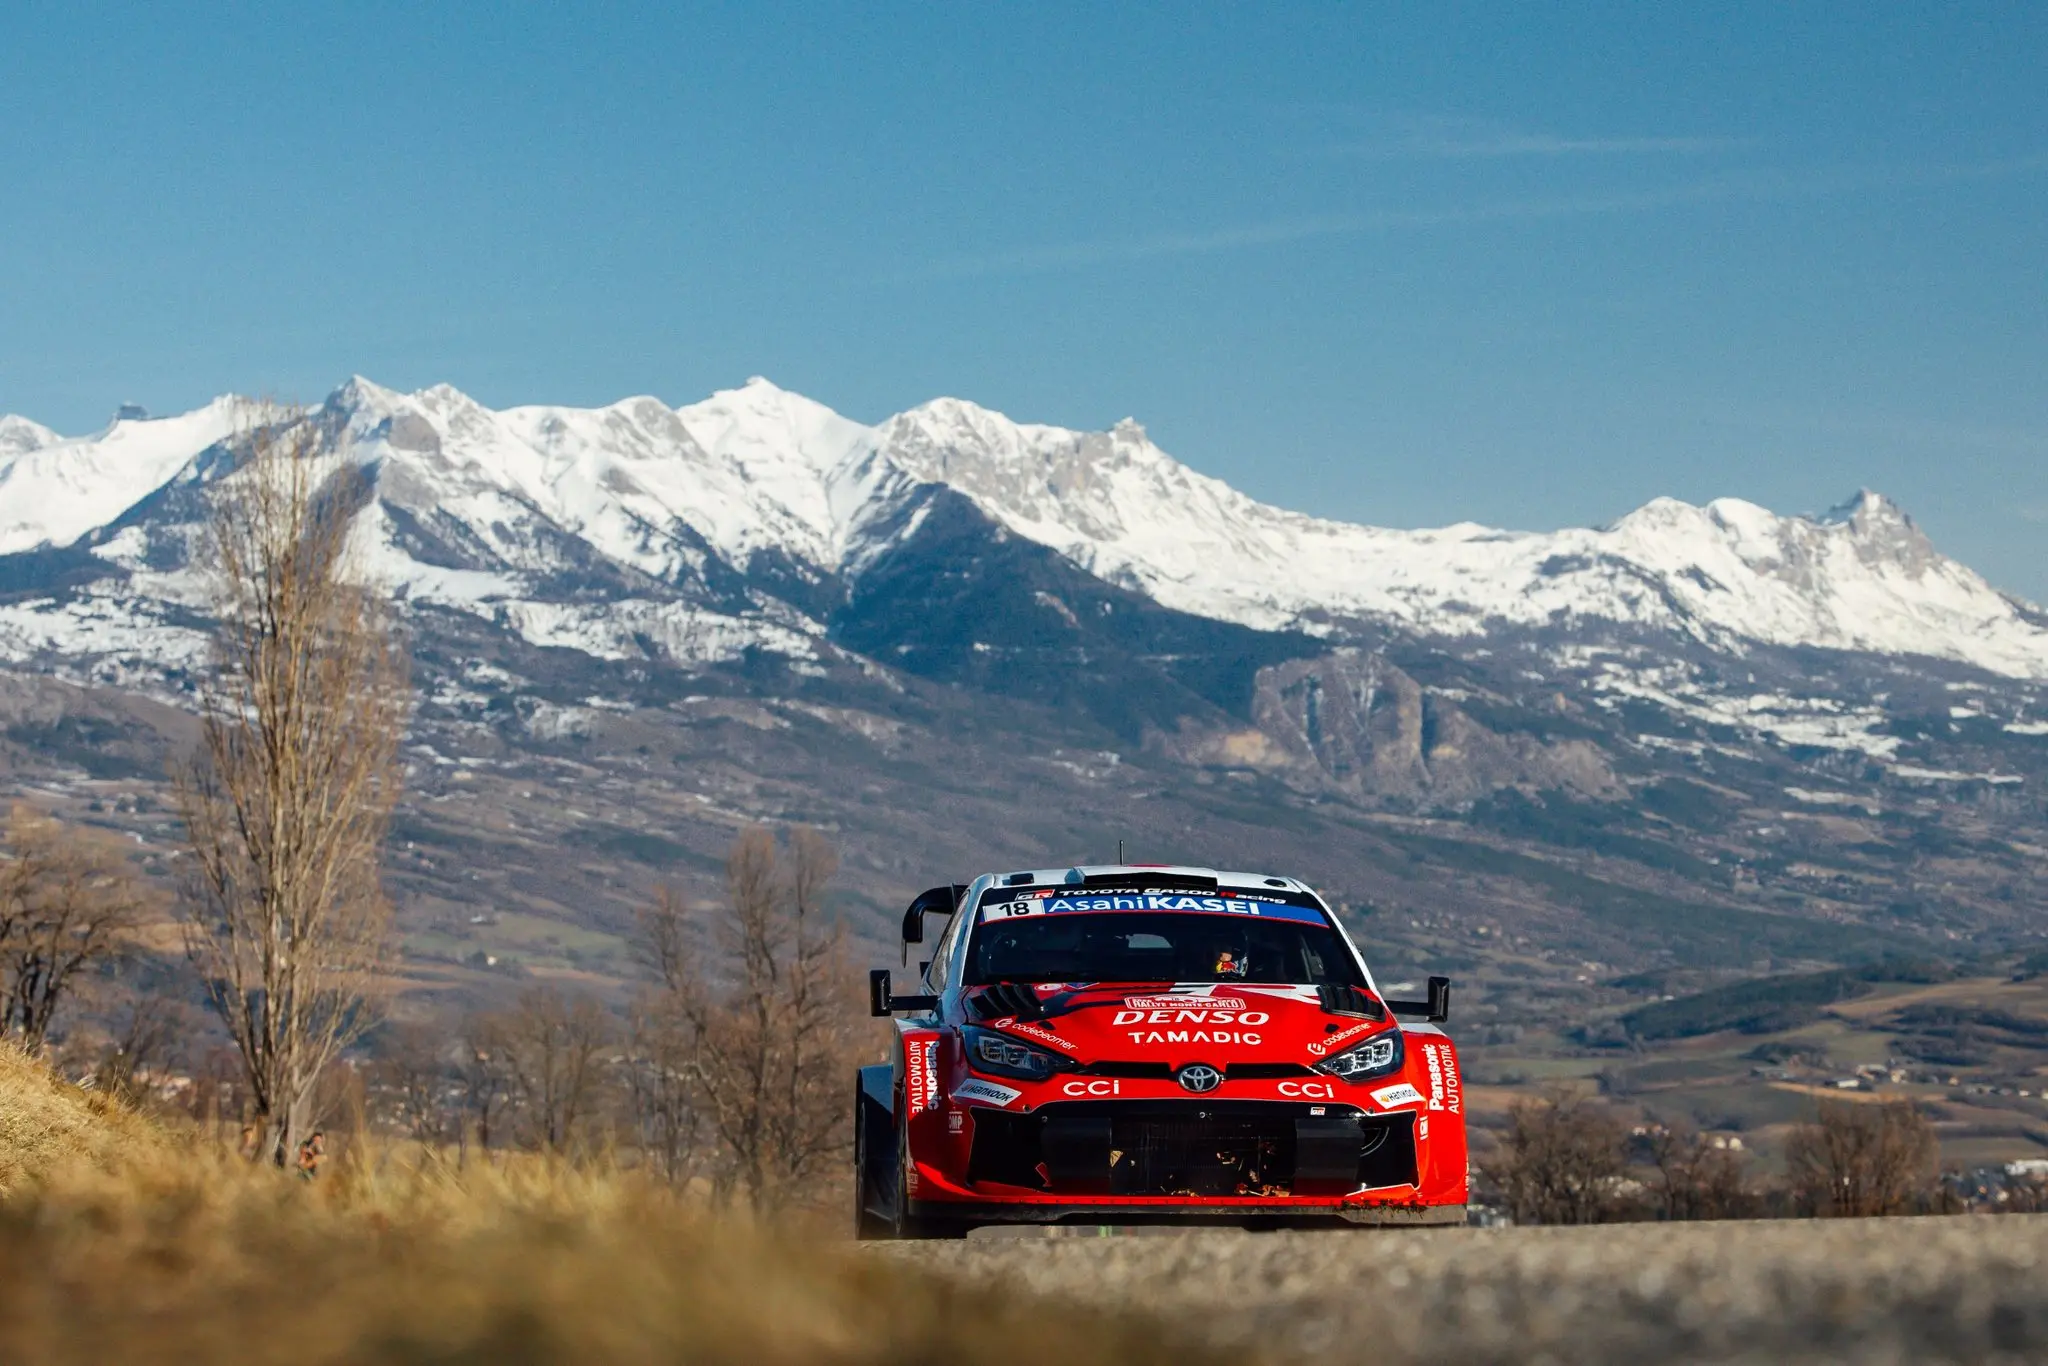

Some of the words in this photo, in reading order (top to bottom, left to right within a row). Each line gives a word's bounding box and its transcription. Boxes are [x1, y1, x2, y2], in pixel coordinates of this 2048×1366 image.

[1059, 888, 1139, 897] TOYOTA
[1143, 888, 1216, 896] GAZOO
[1220, 890, 1287, 905] Racing
[998, 902, 1030, 917] 18
[1133, 999, 1167, 1008] RALLYE
[1112, 1010, 1270, 1026] DENSO
[1128, 1030, 1262, 1045] TAMADIC
[909, 1041, 924, 1114] AUTOMOTIVE
[925, 1041, 941, 1110] Panasonic
[1422, 1044, 1445, 1111] Panasonic
[1438, 1044, 1460, 1114] AUTOMOTIVE
